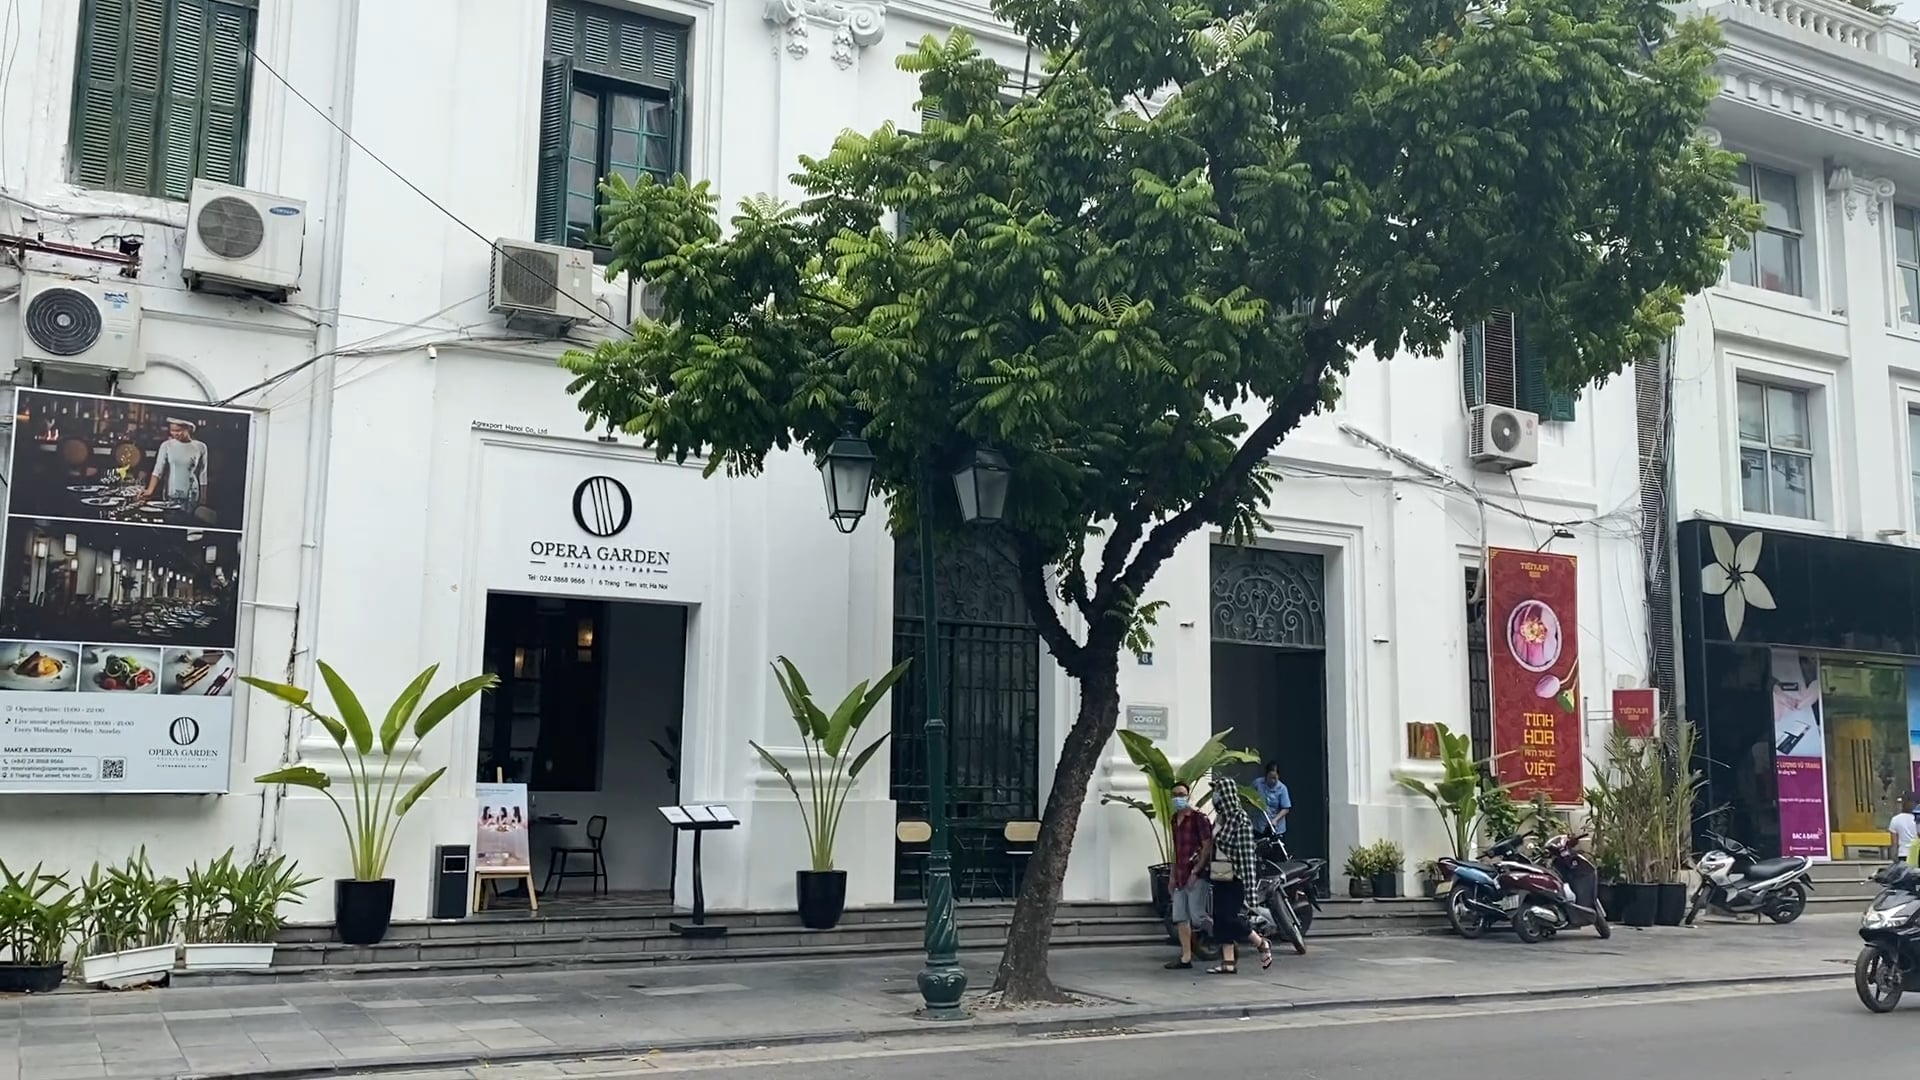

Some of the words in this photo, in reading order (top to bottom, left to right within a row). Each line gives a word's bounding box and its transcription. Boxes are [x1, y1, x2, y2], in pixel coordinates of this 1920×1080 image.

[530, 540, 592, 559] OPERA
[597, 546, 670, 565] GARDEN
[1523, 713, 1554, 727] TINH
[1523, 729, 1555, 745] HOA
